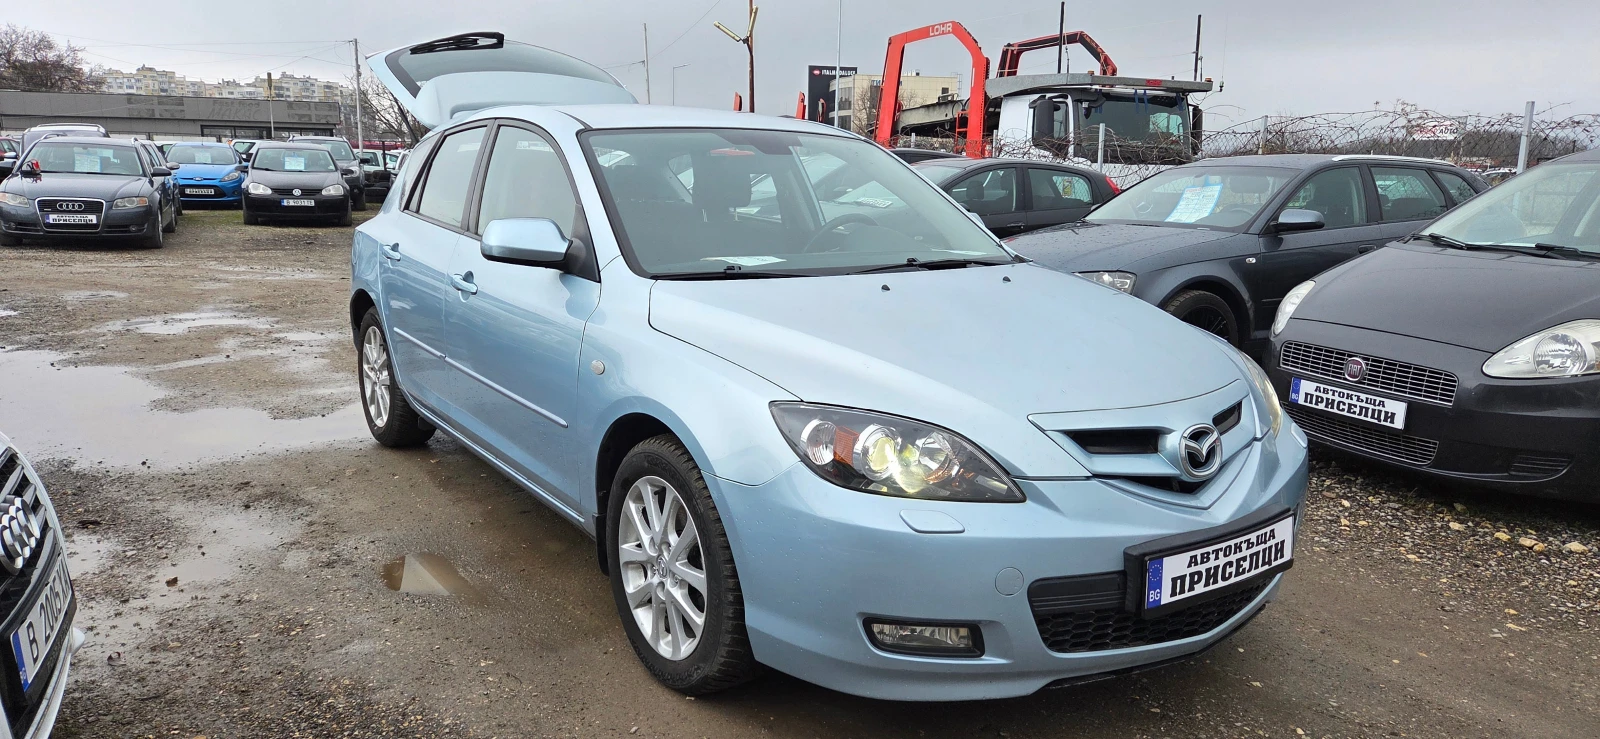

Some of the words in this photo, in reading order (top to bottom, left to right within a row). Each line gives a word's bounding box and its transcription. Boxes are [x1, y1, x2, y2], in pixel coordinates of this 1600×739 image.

[930, 23, 952, 36] LOHR
[1348, 363, 1362, 377] FIAT
[1291, 392, 1299, 401] BG
[1314, 385, 1386, 408] АВТОКЪЩА
[1303, 392, 1397, 425] ПРИСЕЛЦИ
[1187, 528, 1276, 568] АВТОКЪЩА
[1169, 539, 1286, 598] ПРИСЕЛЦИ
[1149, 588, 1161, 602] BG
[26, 620, 39, 666] B
[39, 574, 62, 645] 2005
